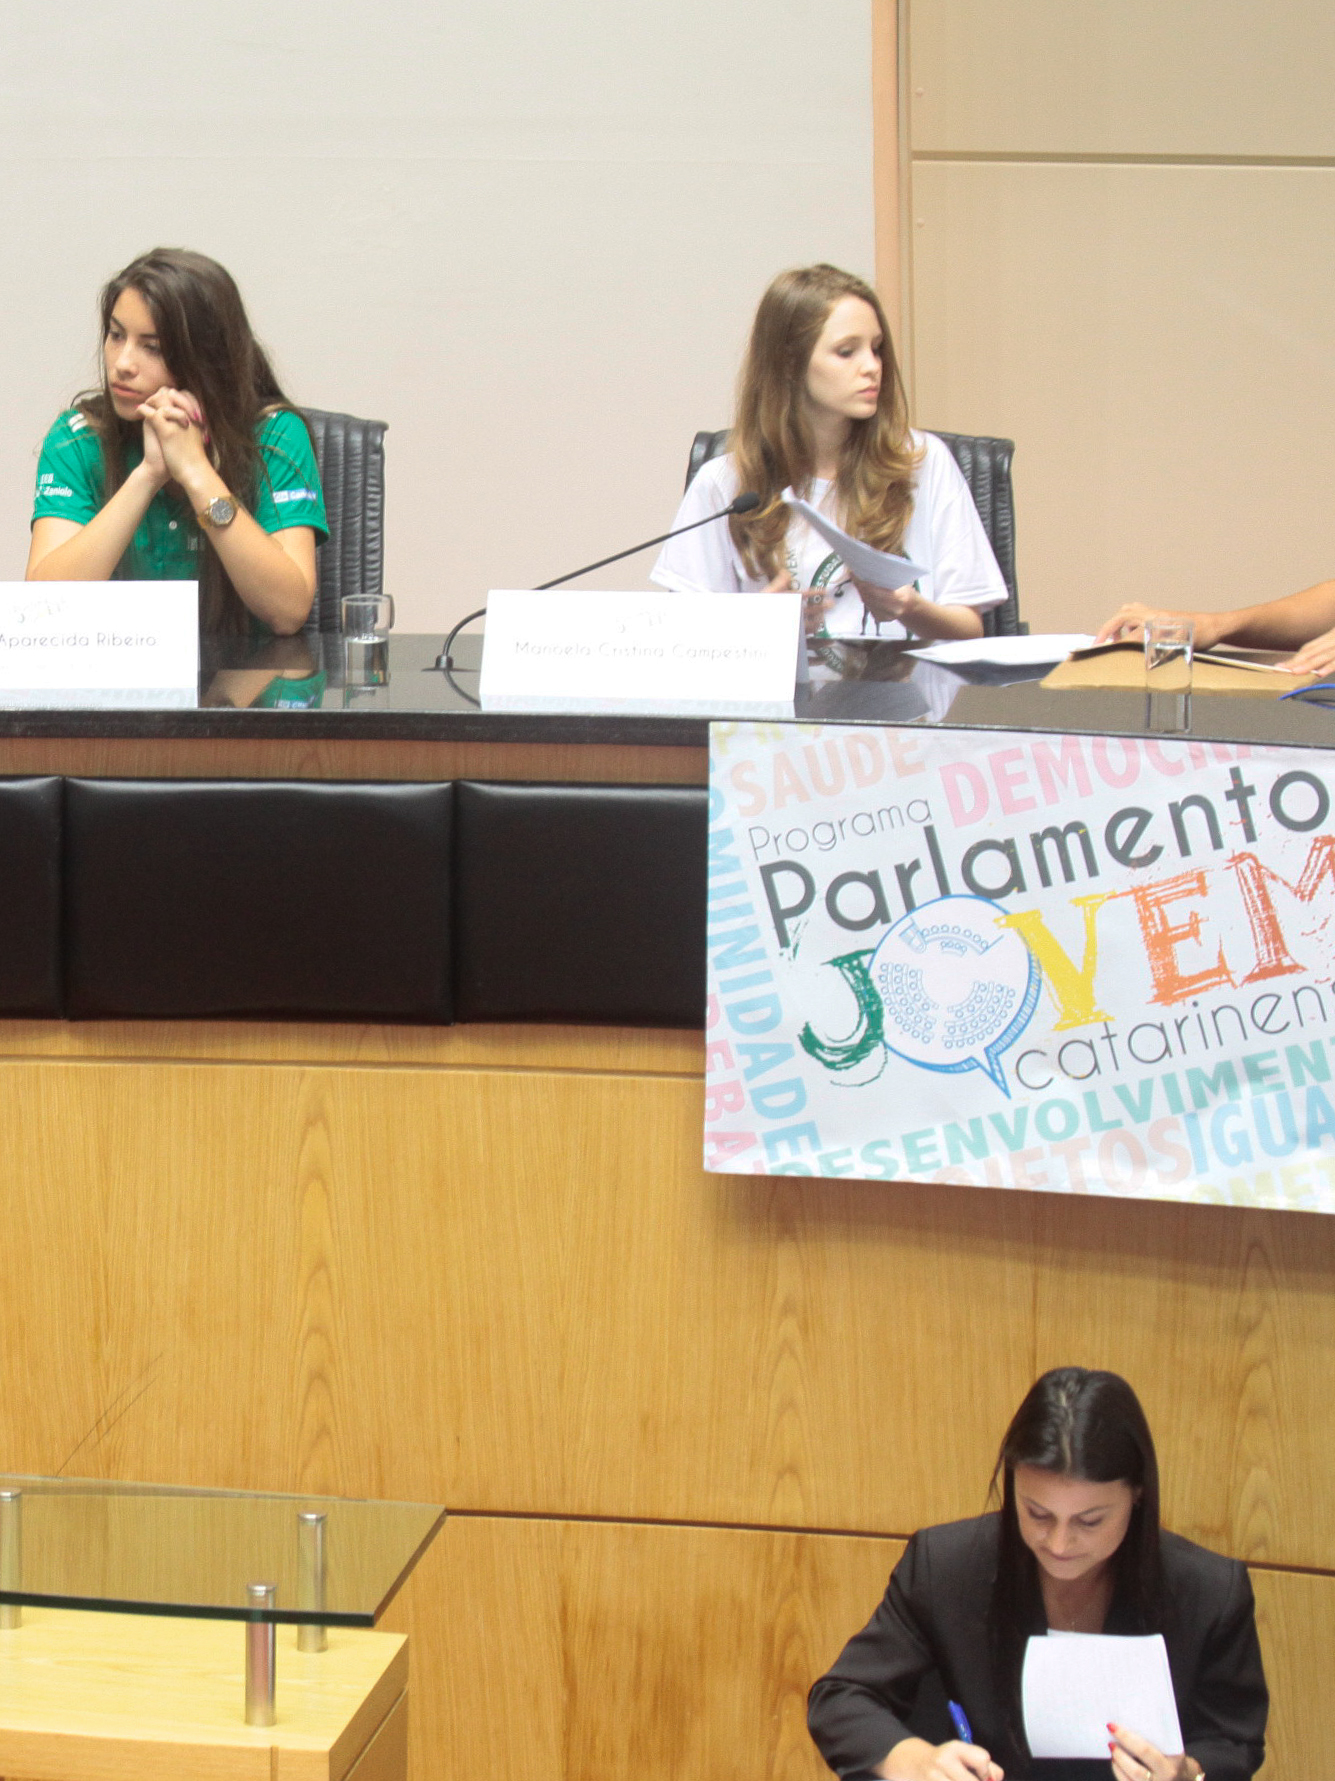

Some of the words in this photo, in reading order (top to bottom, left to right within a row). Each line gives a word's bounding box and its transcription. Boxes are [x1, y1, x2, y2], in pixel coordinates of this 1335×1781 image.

[96, 631, 158, 648] Ribeiro
[747, 798, 933, 862] Programa
[758, 766, 1331, 949] Parlamento
[1015, 981, 1335, 1091] catarinen
